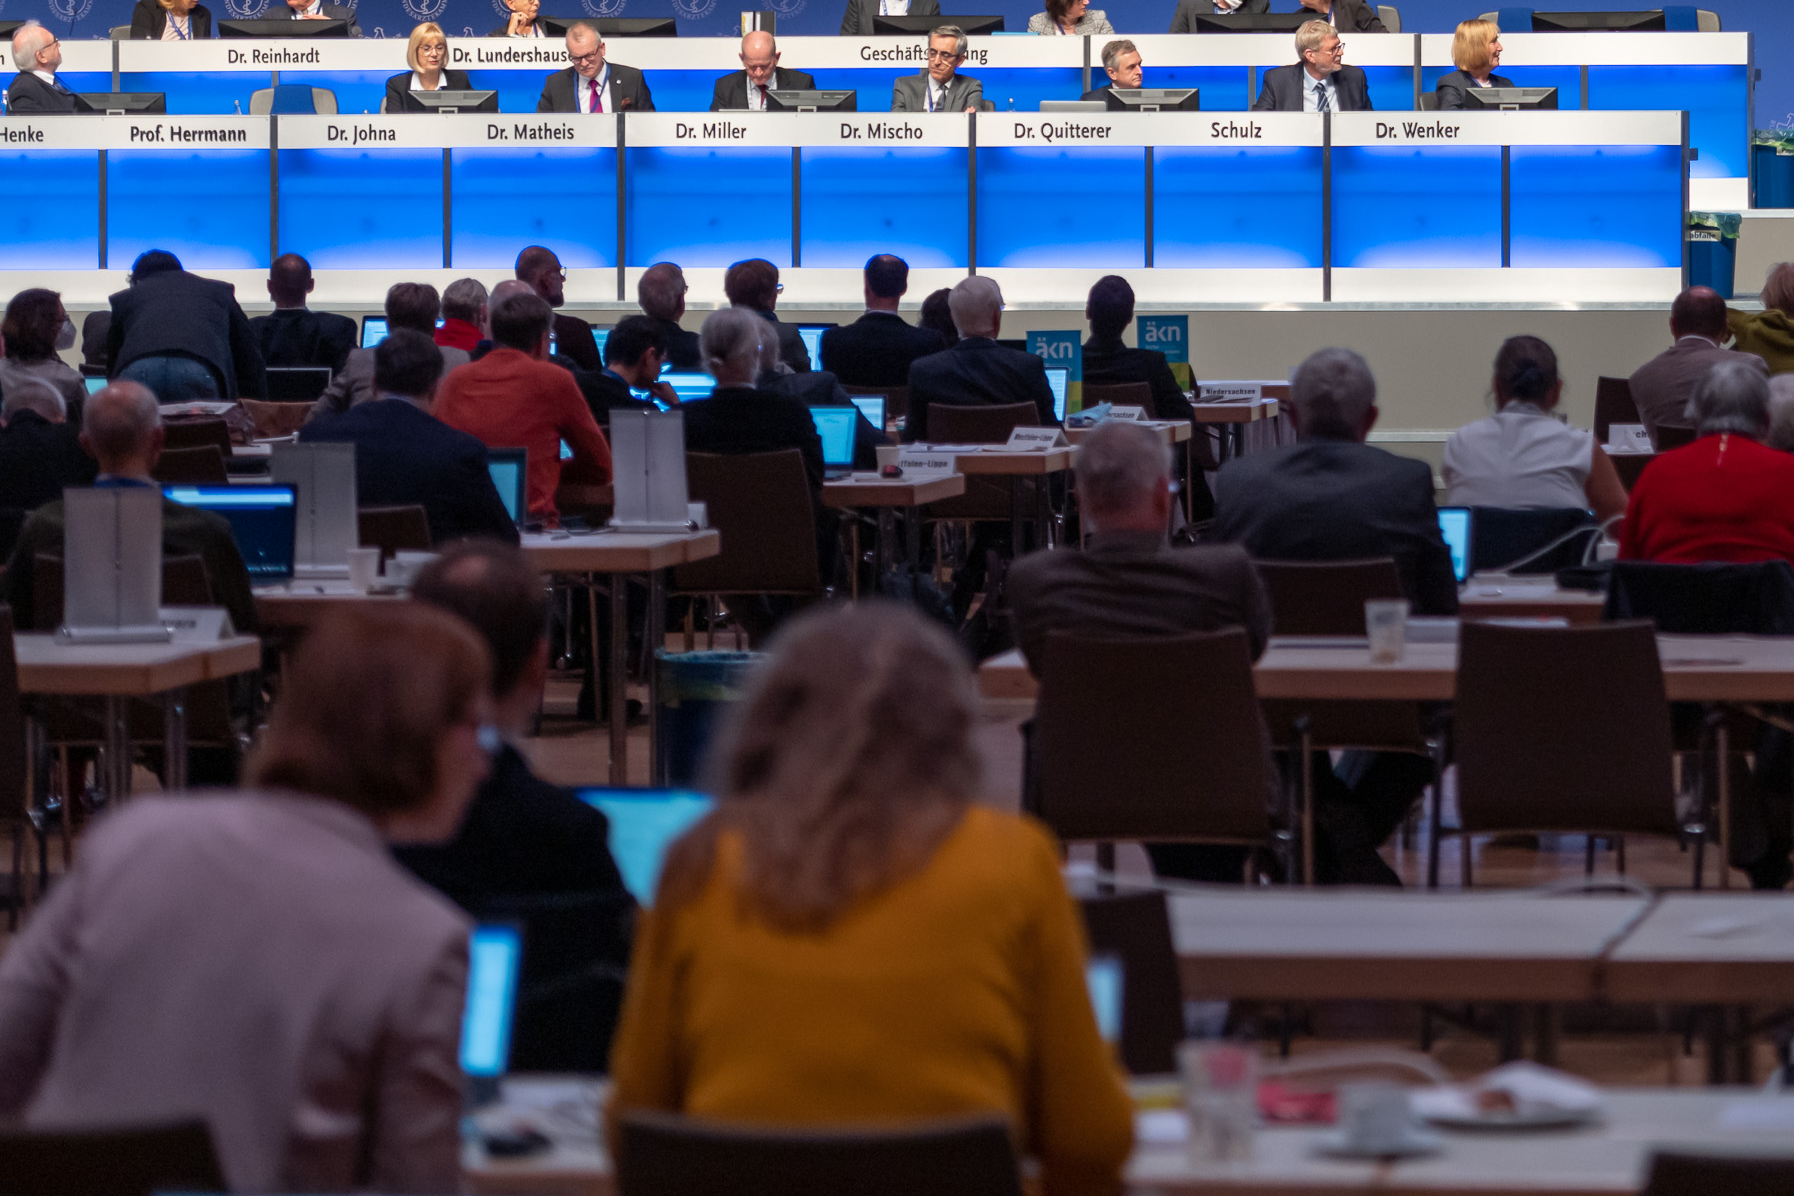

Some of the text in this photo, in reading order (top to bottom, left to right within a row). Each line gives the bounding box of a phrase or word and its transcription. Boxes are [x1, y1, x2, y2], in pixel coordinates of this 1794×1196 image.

[229, 48, 319, 63] Dr. Reinhardt
[454, 48, 472, 62] Dr.
[0, 125, 43, 142] Henke
[131, 125, 246, 141] Prof. Herrmann
[328, 124, 395, 145] Dr. Johna
[488, 123, 574, 139] Dr. Matheis
[677, 122, 746, 138] Dr. Miller
[841, 122, 922, 139] Dr. Mischo
[1015, 122, 1111, 142] Dr. Quitterer
[1211, 121, 1261, 138] Schulz
[1376, 121, 1459, 138] Dr. Wenker
[1145, 321, 1181, 342] äkn
